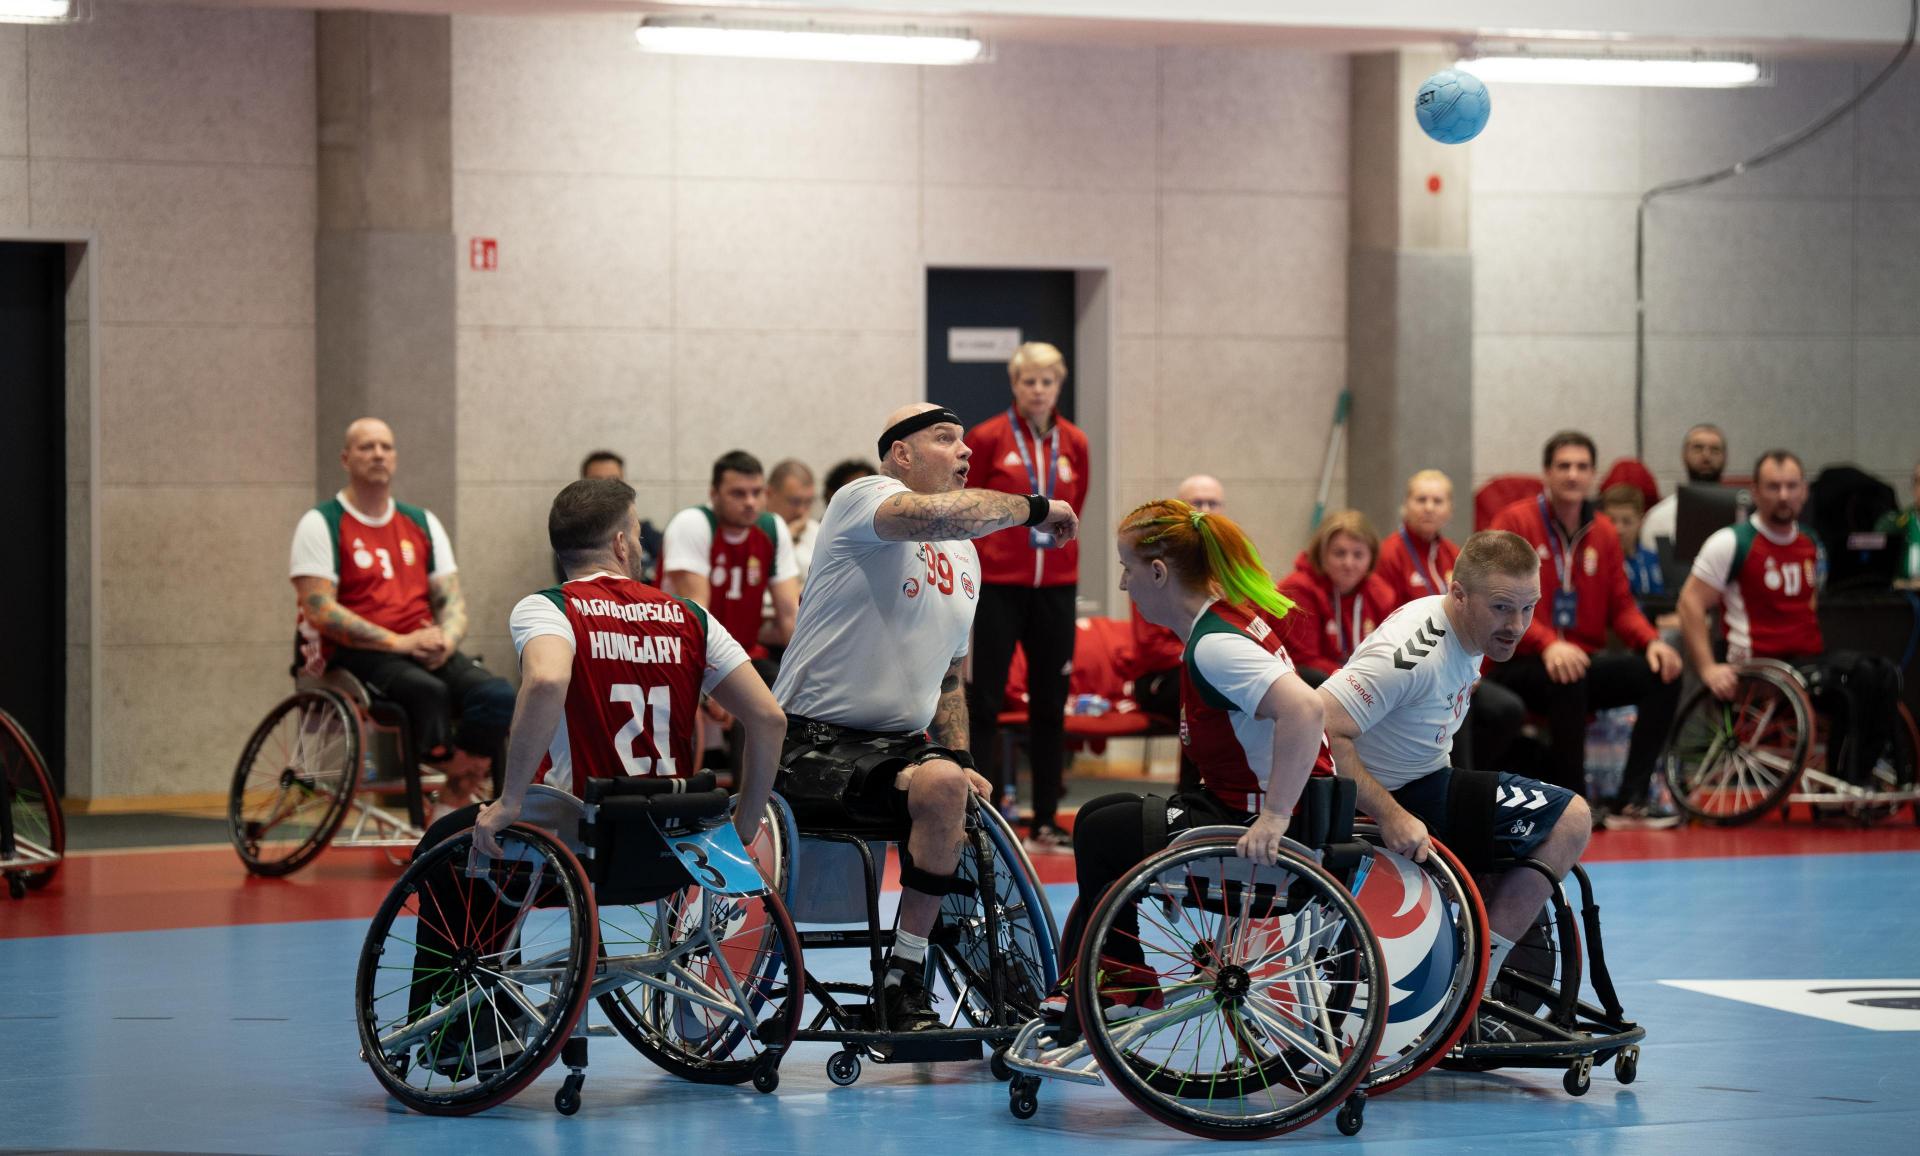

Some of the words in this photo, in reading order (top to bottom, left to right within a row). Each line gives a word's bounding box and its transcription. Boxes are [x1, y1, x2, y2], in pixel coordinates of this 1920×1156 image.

[1417, 90, 1435, 107] ECT
[375, 548, 394, 580] 3
[925, 543, 954, 595] 99
[725, 566, 742, 600] 1
[589, 631, 681, 664] HUNGARY
[1346, 674, 1375, 708] Scandic
[610, 684, 676, 776] 21
[675, 842, 728, 889] 3
